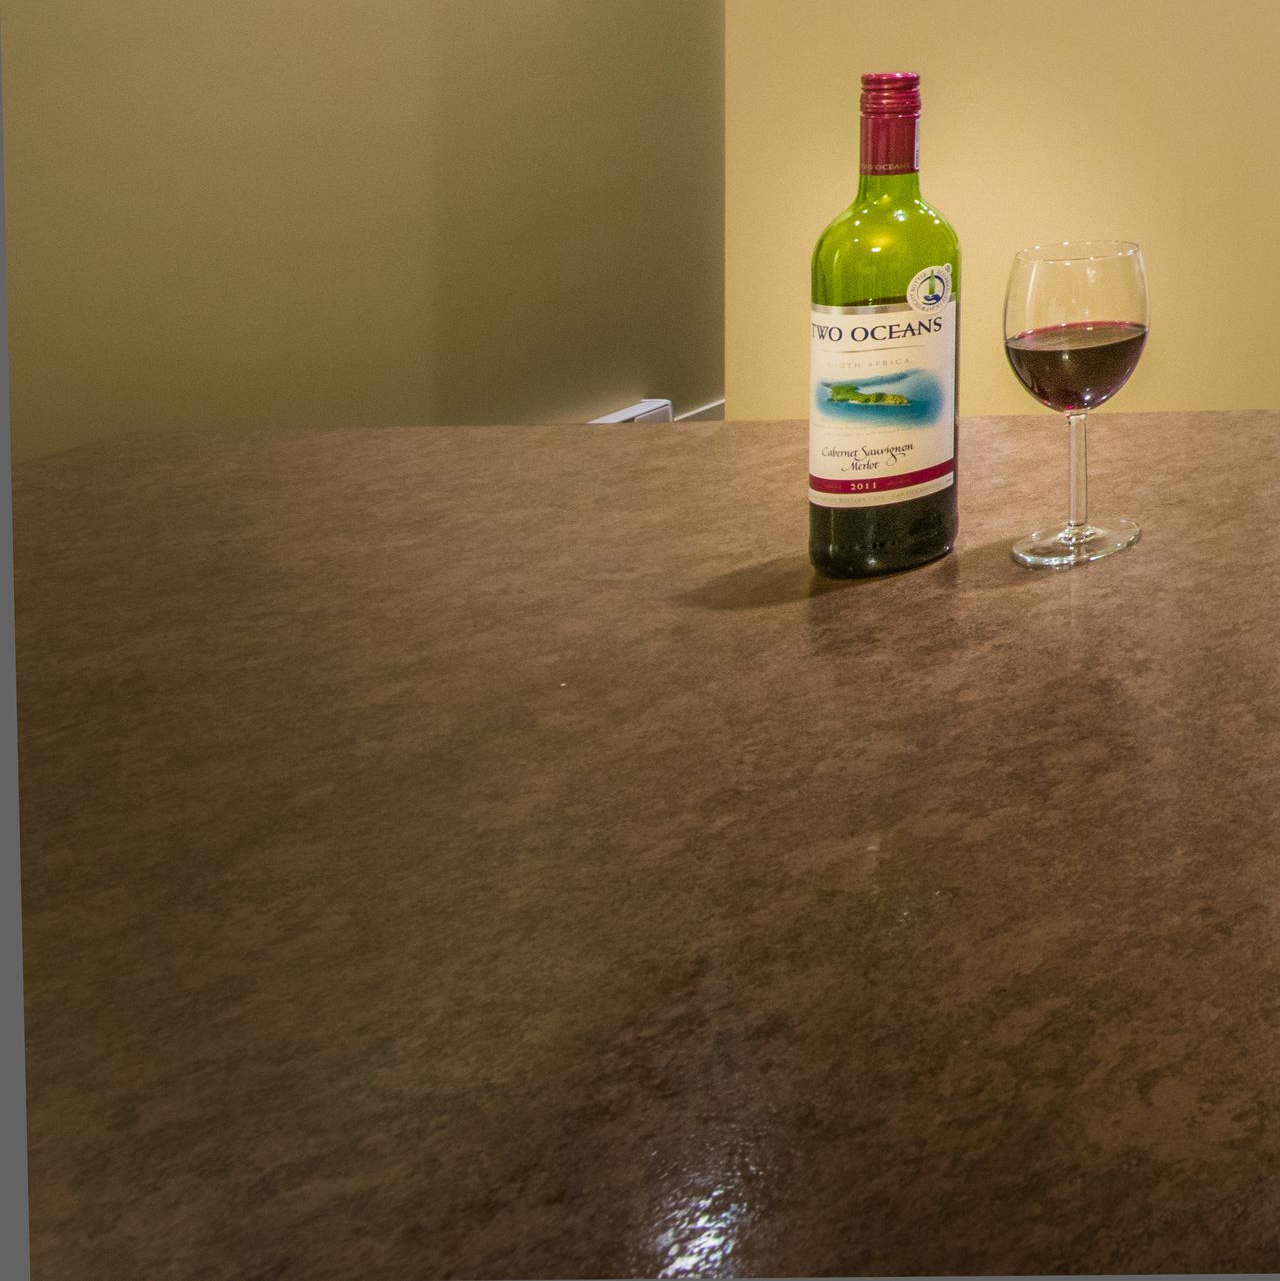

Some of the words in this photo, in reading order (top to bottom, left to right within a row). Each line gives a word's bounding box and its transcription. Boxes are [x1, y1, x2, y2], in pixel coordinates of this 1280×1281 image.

[811, 322, 843, 342] TWO
[850, 316, 943, 343] OCEANS
[821, 446, 859, 458] Cabernet
[854, 443, 914, 467] Sauvignon
[841, 459, 880, 472] Merlot
[850, 481, 877, 491] 2011
